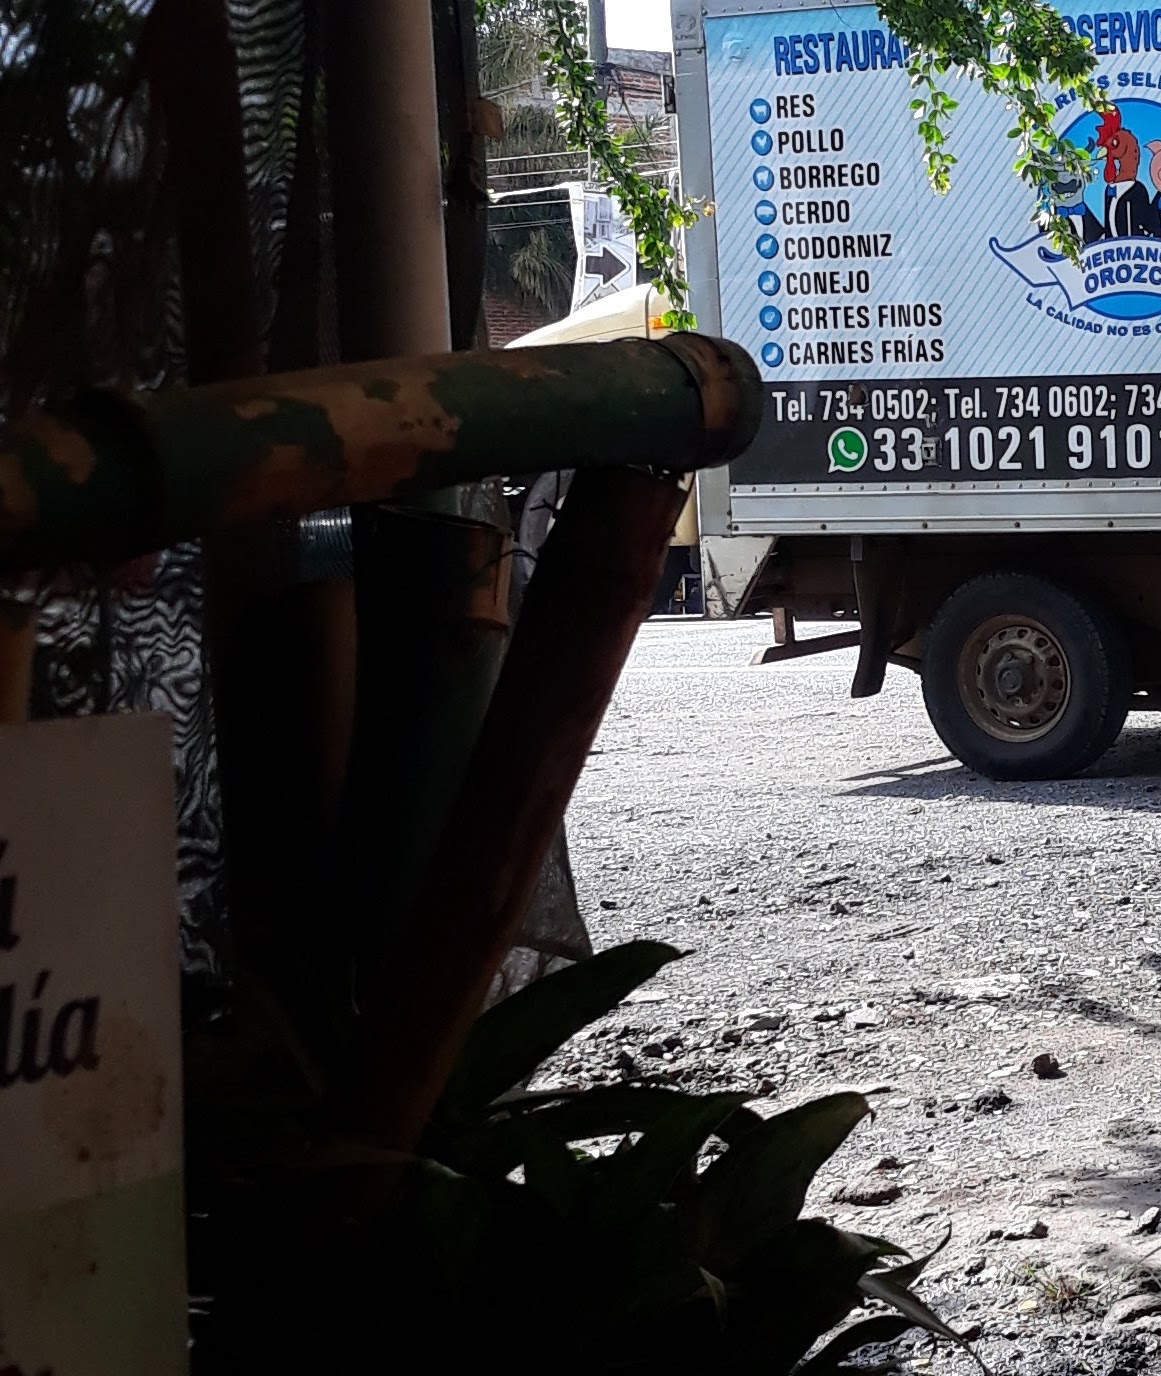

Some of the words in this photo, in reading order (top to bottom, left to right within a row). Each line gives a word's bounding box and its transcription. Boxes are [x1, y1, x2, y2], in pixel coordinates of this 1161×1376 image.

[773, 28, 911, 76] RESTAURA
[776, 93, 816, 119] RES
[777, 128, 845, 155] POLLO
[779, 162, 881, 190] BORREGO
[782, 199, 851, 226] CERDO
[784, 233, 893, 261] CODORNIZ
[786, 269, 870, 296] CONEJO
[787, 305, 870, 331] CORTES
[878, 302, 943, 329] FINOS
[1025, 292, 1043, 311] LA
[1046, 305, 1103, 335] CALIDAD
[1106, 324, 1129, 337] NO
[1132, 324, 1151, 337] ES
[789, 340, 874, 366] CARNES
[881, 333, 945, 364] FRÍAS
[771, 391, 813, 422] Tel.
[944, 387, 988, 419] Tel.
[996, 386, 1041, 418] 734
[1048, 385, 1118, 420] 0602;
[873, 427, 924, 472] 33
[944, 424, 1046, 471] 1021
